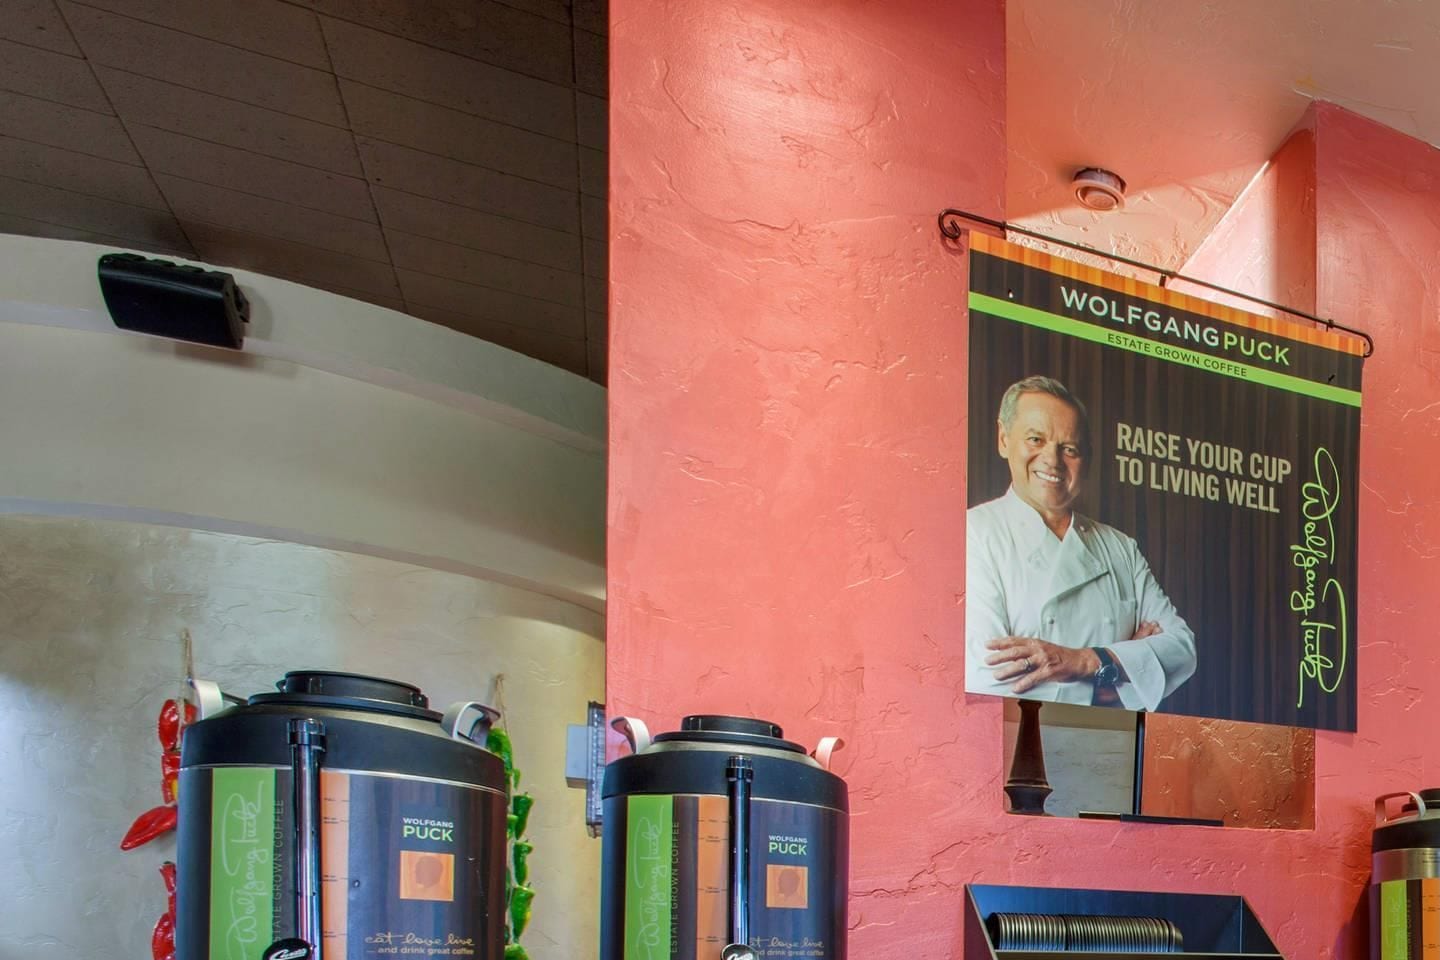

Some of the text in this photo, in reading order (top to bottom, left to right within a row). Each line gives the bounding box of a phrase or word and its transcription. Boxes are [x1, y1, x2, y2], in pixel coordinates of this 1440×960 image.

[1108, 333, 1248, 377] ESTATE GROWN COFFEE
[1117, 422, 1292, 484] RAISE YOUR CUP
[1115, 455, 1280, 513] TO LIVING WELL
[403, 817, 454, 828] WOLFGANG
[403, 826, 453, 842] PUCK
[768, 835, 808, 843] WOLFGANG
[768, 842, 807, 855] PUCK
[273, 800, 284, 942] STATE GROWN COFFEE
[670, 822, 680, 953] ESTATE GROWN COFFEE
[400, 946, 425, 954] drink
[427, 948, 451, 956] great
